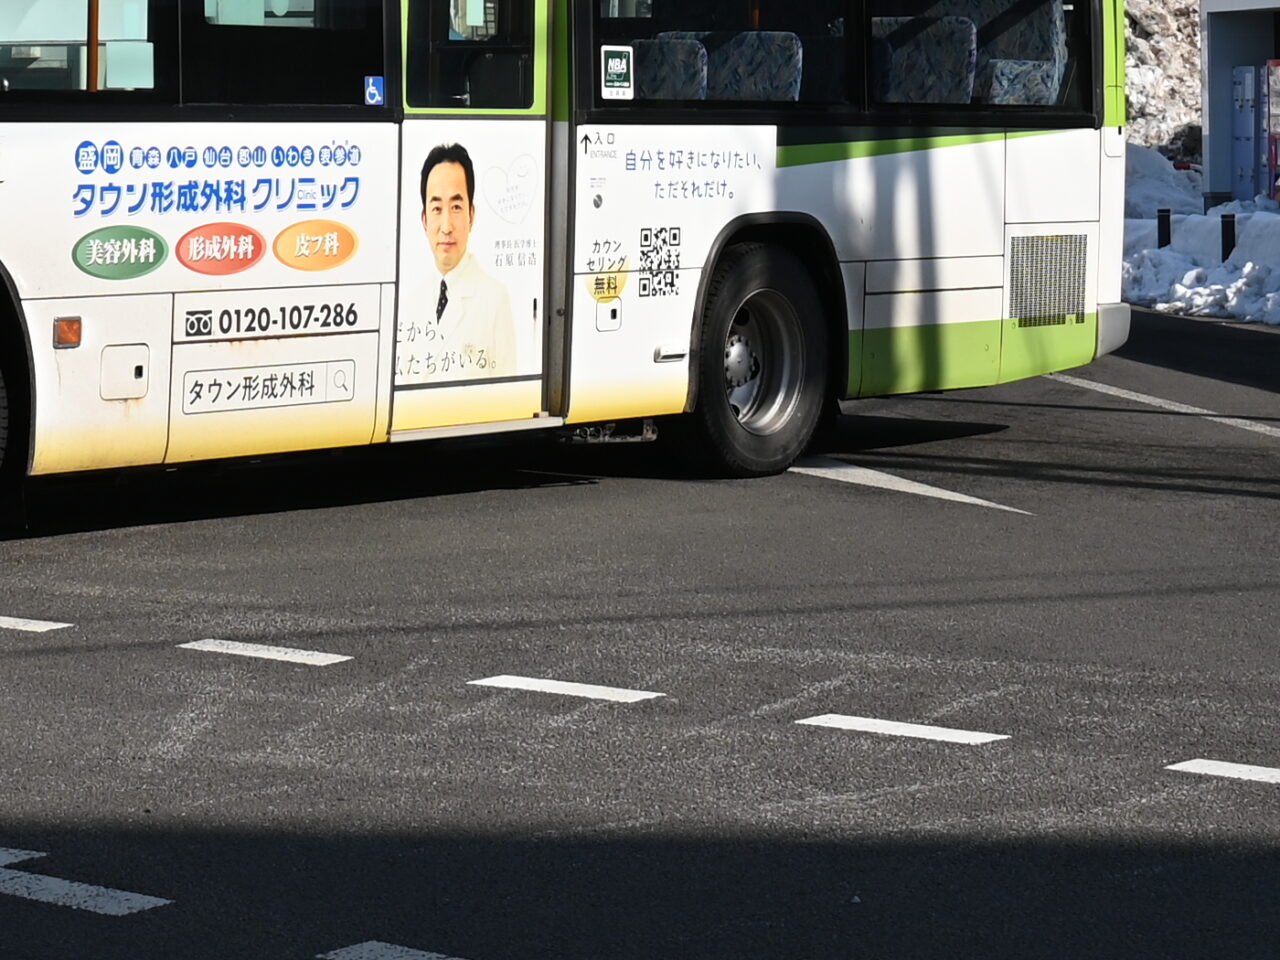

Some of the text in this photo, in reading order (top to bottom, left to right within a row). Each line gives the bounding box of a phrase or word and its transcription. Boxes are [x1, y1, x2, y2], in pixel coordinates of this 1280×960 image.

[607, 57, 627, 73] NBA
[594, 131, 615, 145] 入口
[76, 142, 361, 173] 盛岡 青森 八戸 仙台 郡山 いわき 表参道
[590, 150, 617, 159] ENTRANCE
[624, 148, 763, 171] 自分を好きになりたい、
[72, 177, 360, 216] タウン形成外科クリニック
[297, 188, 317, 201] Clinic
[653, 179, 735, 200] ただそれだけ。
[85, 238, 156, 266] 美容外科
[188, 234, 255, 261] 形成外科
[294, 231, 340, 258] 皮フ科
[592, 238, 622, 254] カウン
[586, 254, 628, 272] セリング
[593, 275, 618, 296] 無料
[218, 303, 358, 334] 0120-107-286
[188, 370, 316, 405] タウン形成外科
